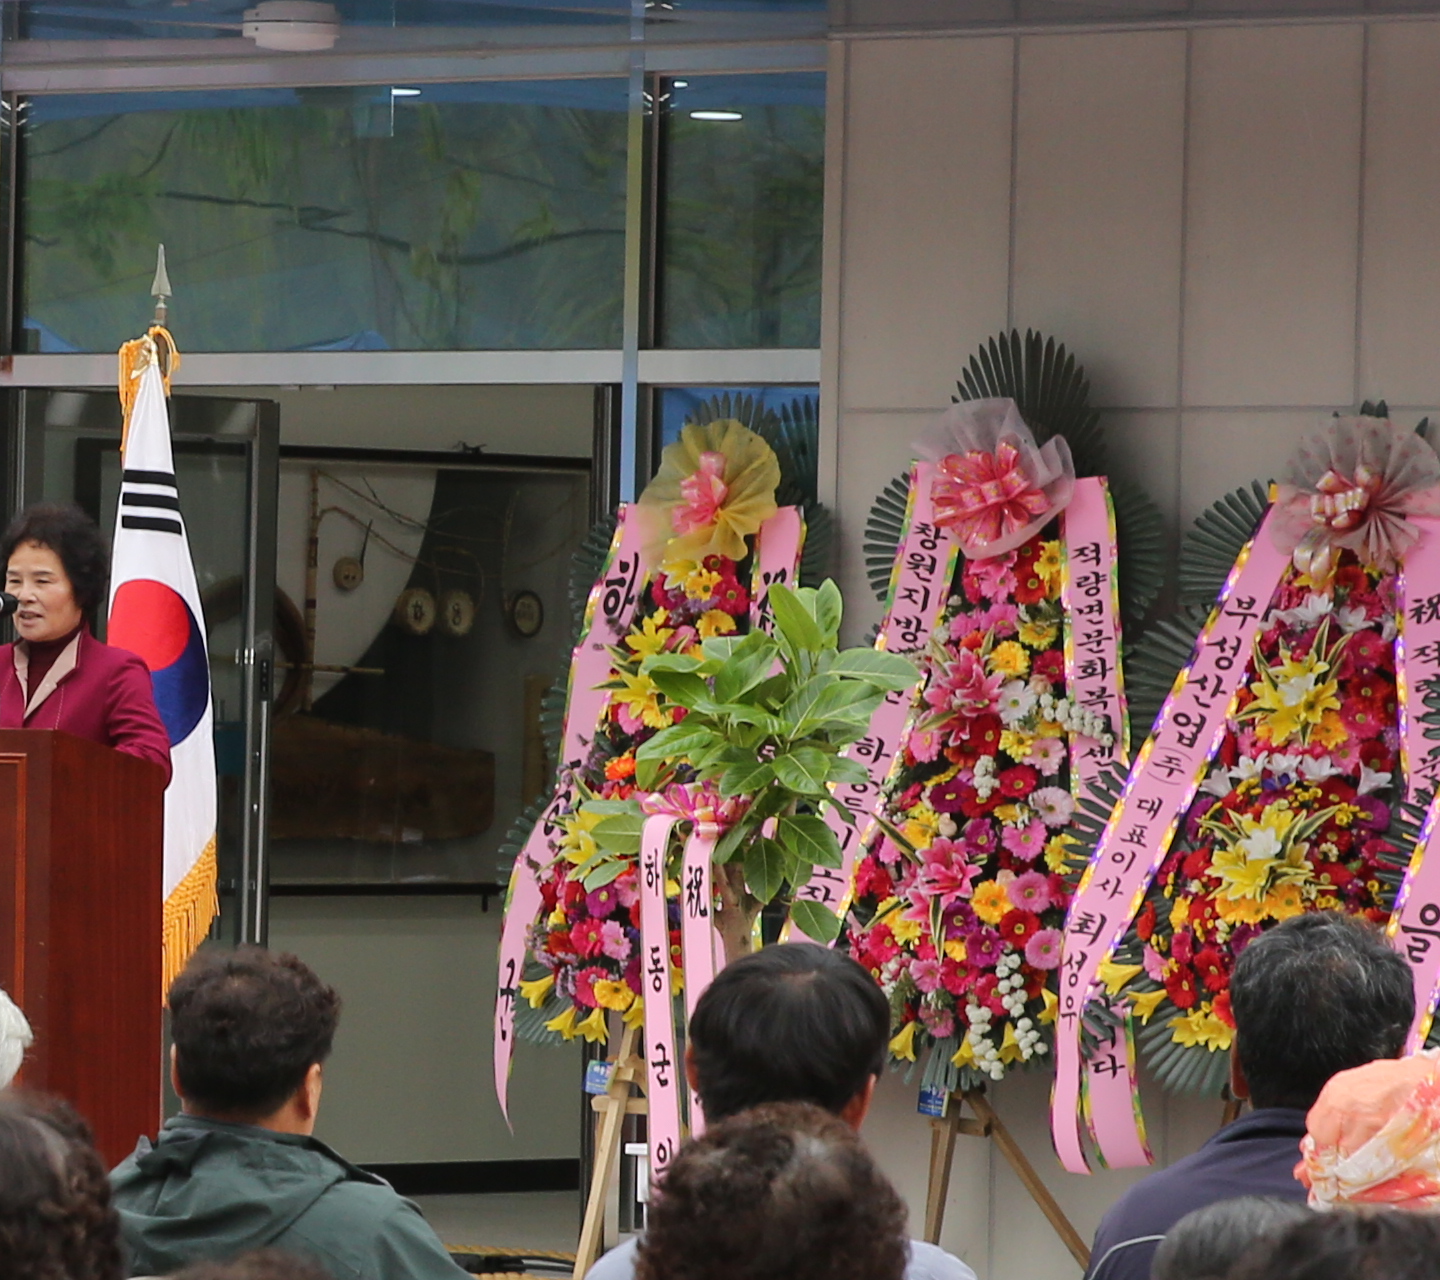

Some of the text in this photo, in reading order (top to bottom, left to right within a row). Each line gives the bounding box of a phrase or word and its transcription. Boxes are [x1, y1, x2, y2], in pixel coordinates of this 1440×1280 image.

[686, 865, 708, 919] 祝
[1094, 796, 1164, 901] 대표이사
[1060, 912, 1109, 1018] 최성우
